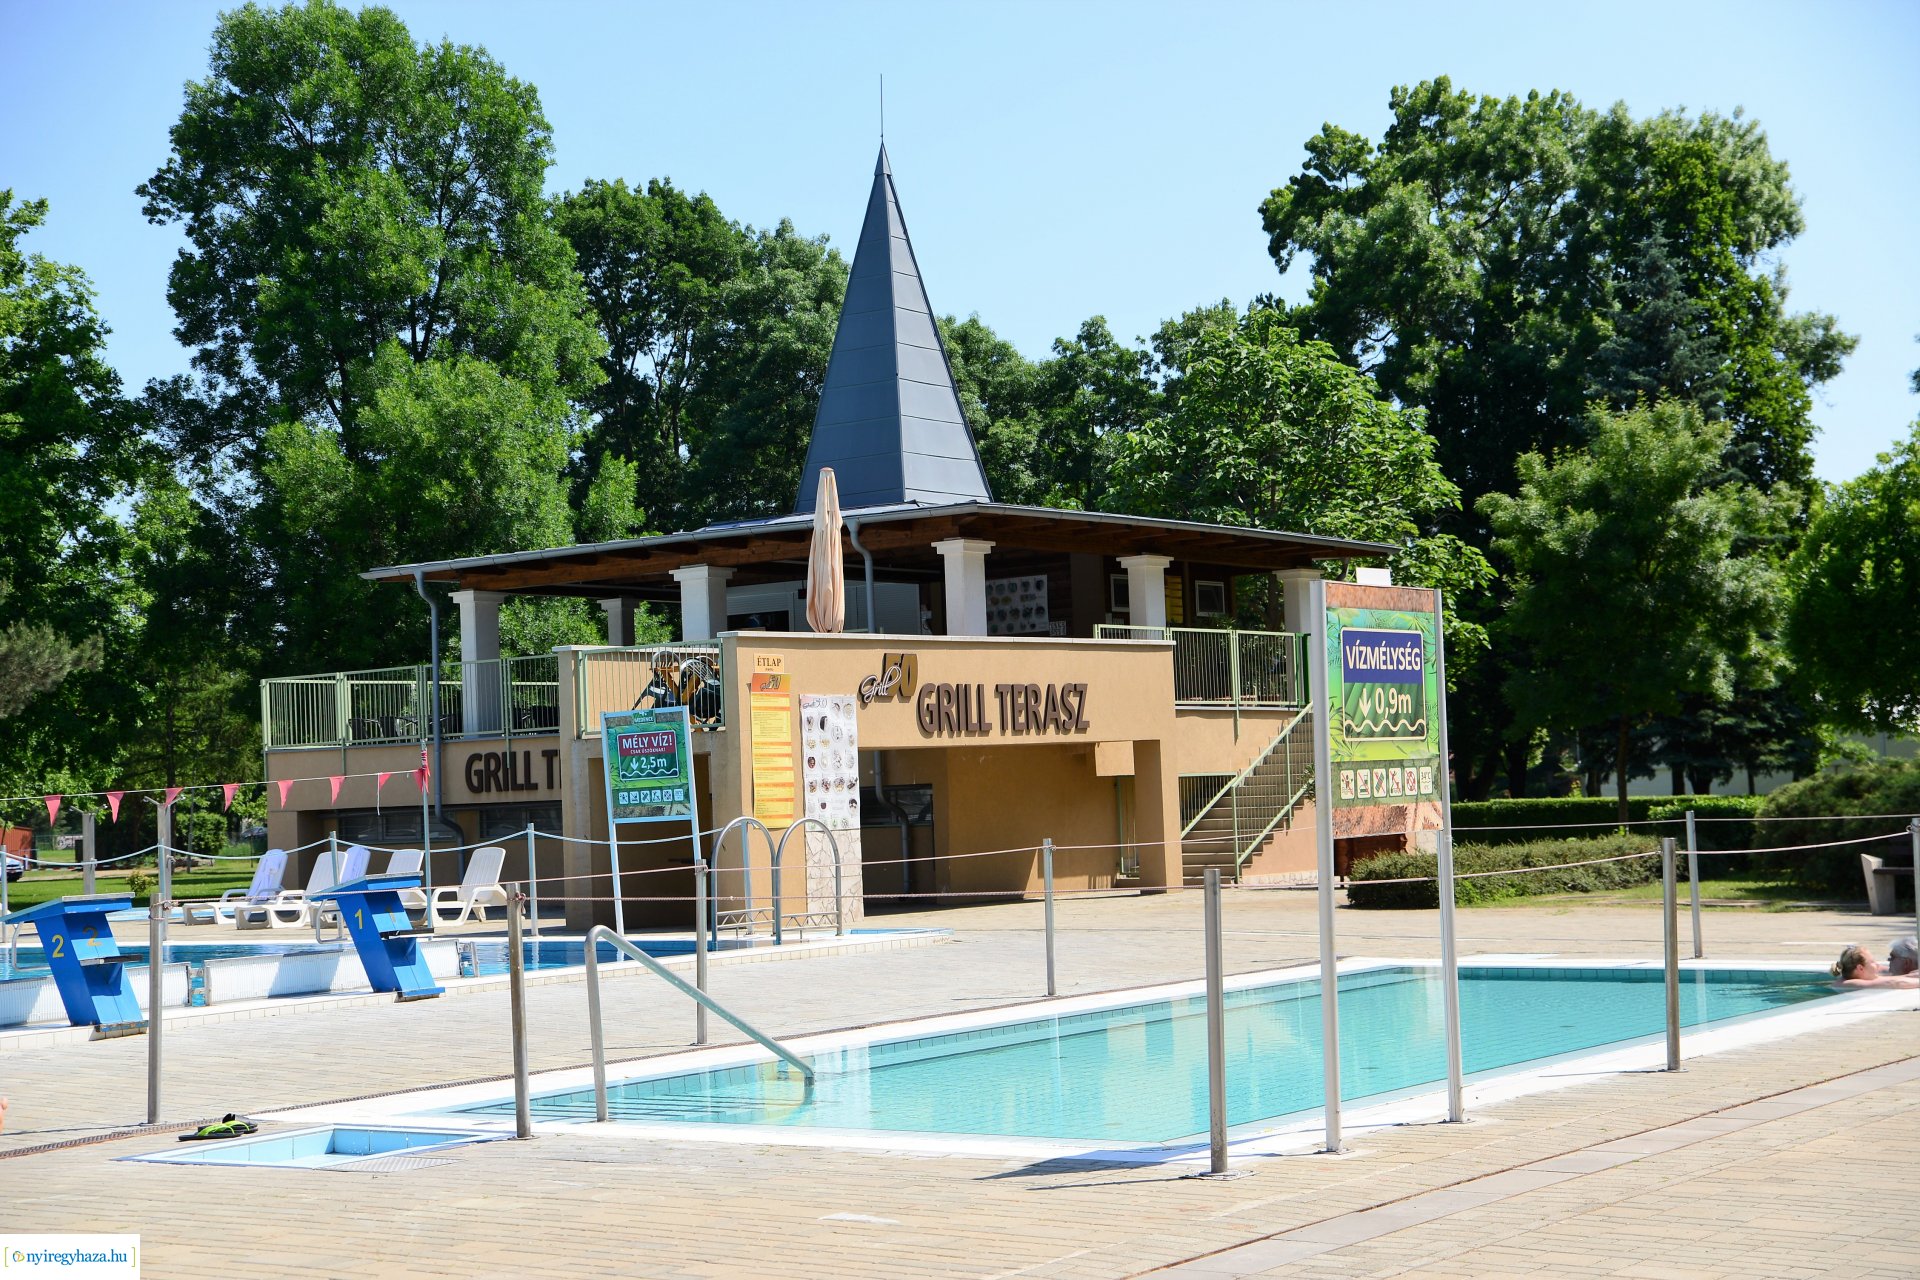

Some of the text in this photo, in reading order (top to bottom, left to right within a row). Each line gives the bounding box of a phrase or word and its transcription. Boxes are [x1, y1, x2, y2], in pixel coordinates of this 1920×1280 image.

[757, 656, 782, 667] ÉTLAP
[1346, 639, 1421, 671] VÍZMÉLYSÉG
[860, 664, 901, 703] Grill
[917, 682, 1090, 733] GRILL TERASZ
[1375, 688, 1412, 720] 0,9m
[622, 733, 673, 749] MÉLY VÍZ!
[465, 749, 561, 793] GRILL T
[641, 757, 667, 769] 2,5m
[354, 908, 363, 929] 1
[52, 934, 65, 958] 2
[82, 925, 102, 947] 2
